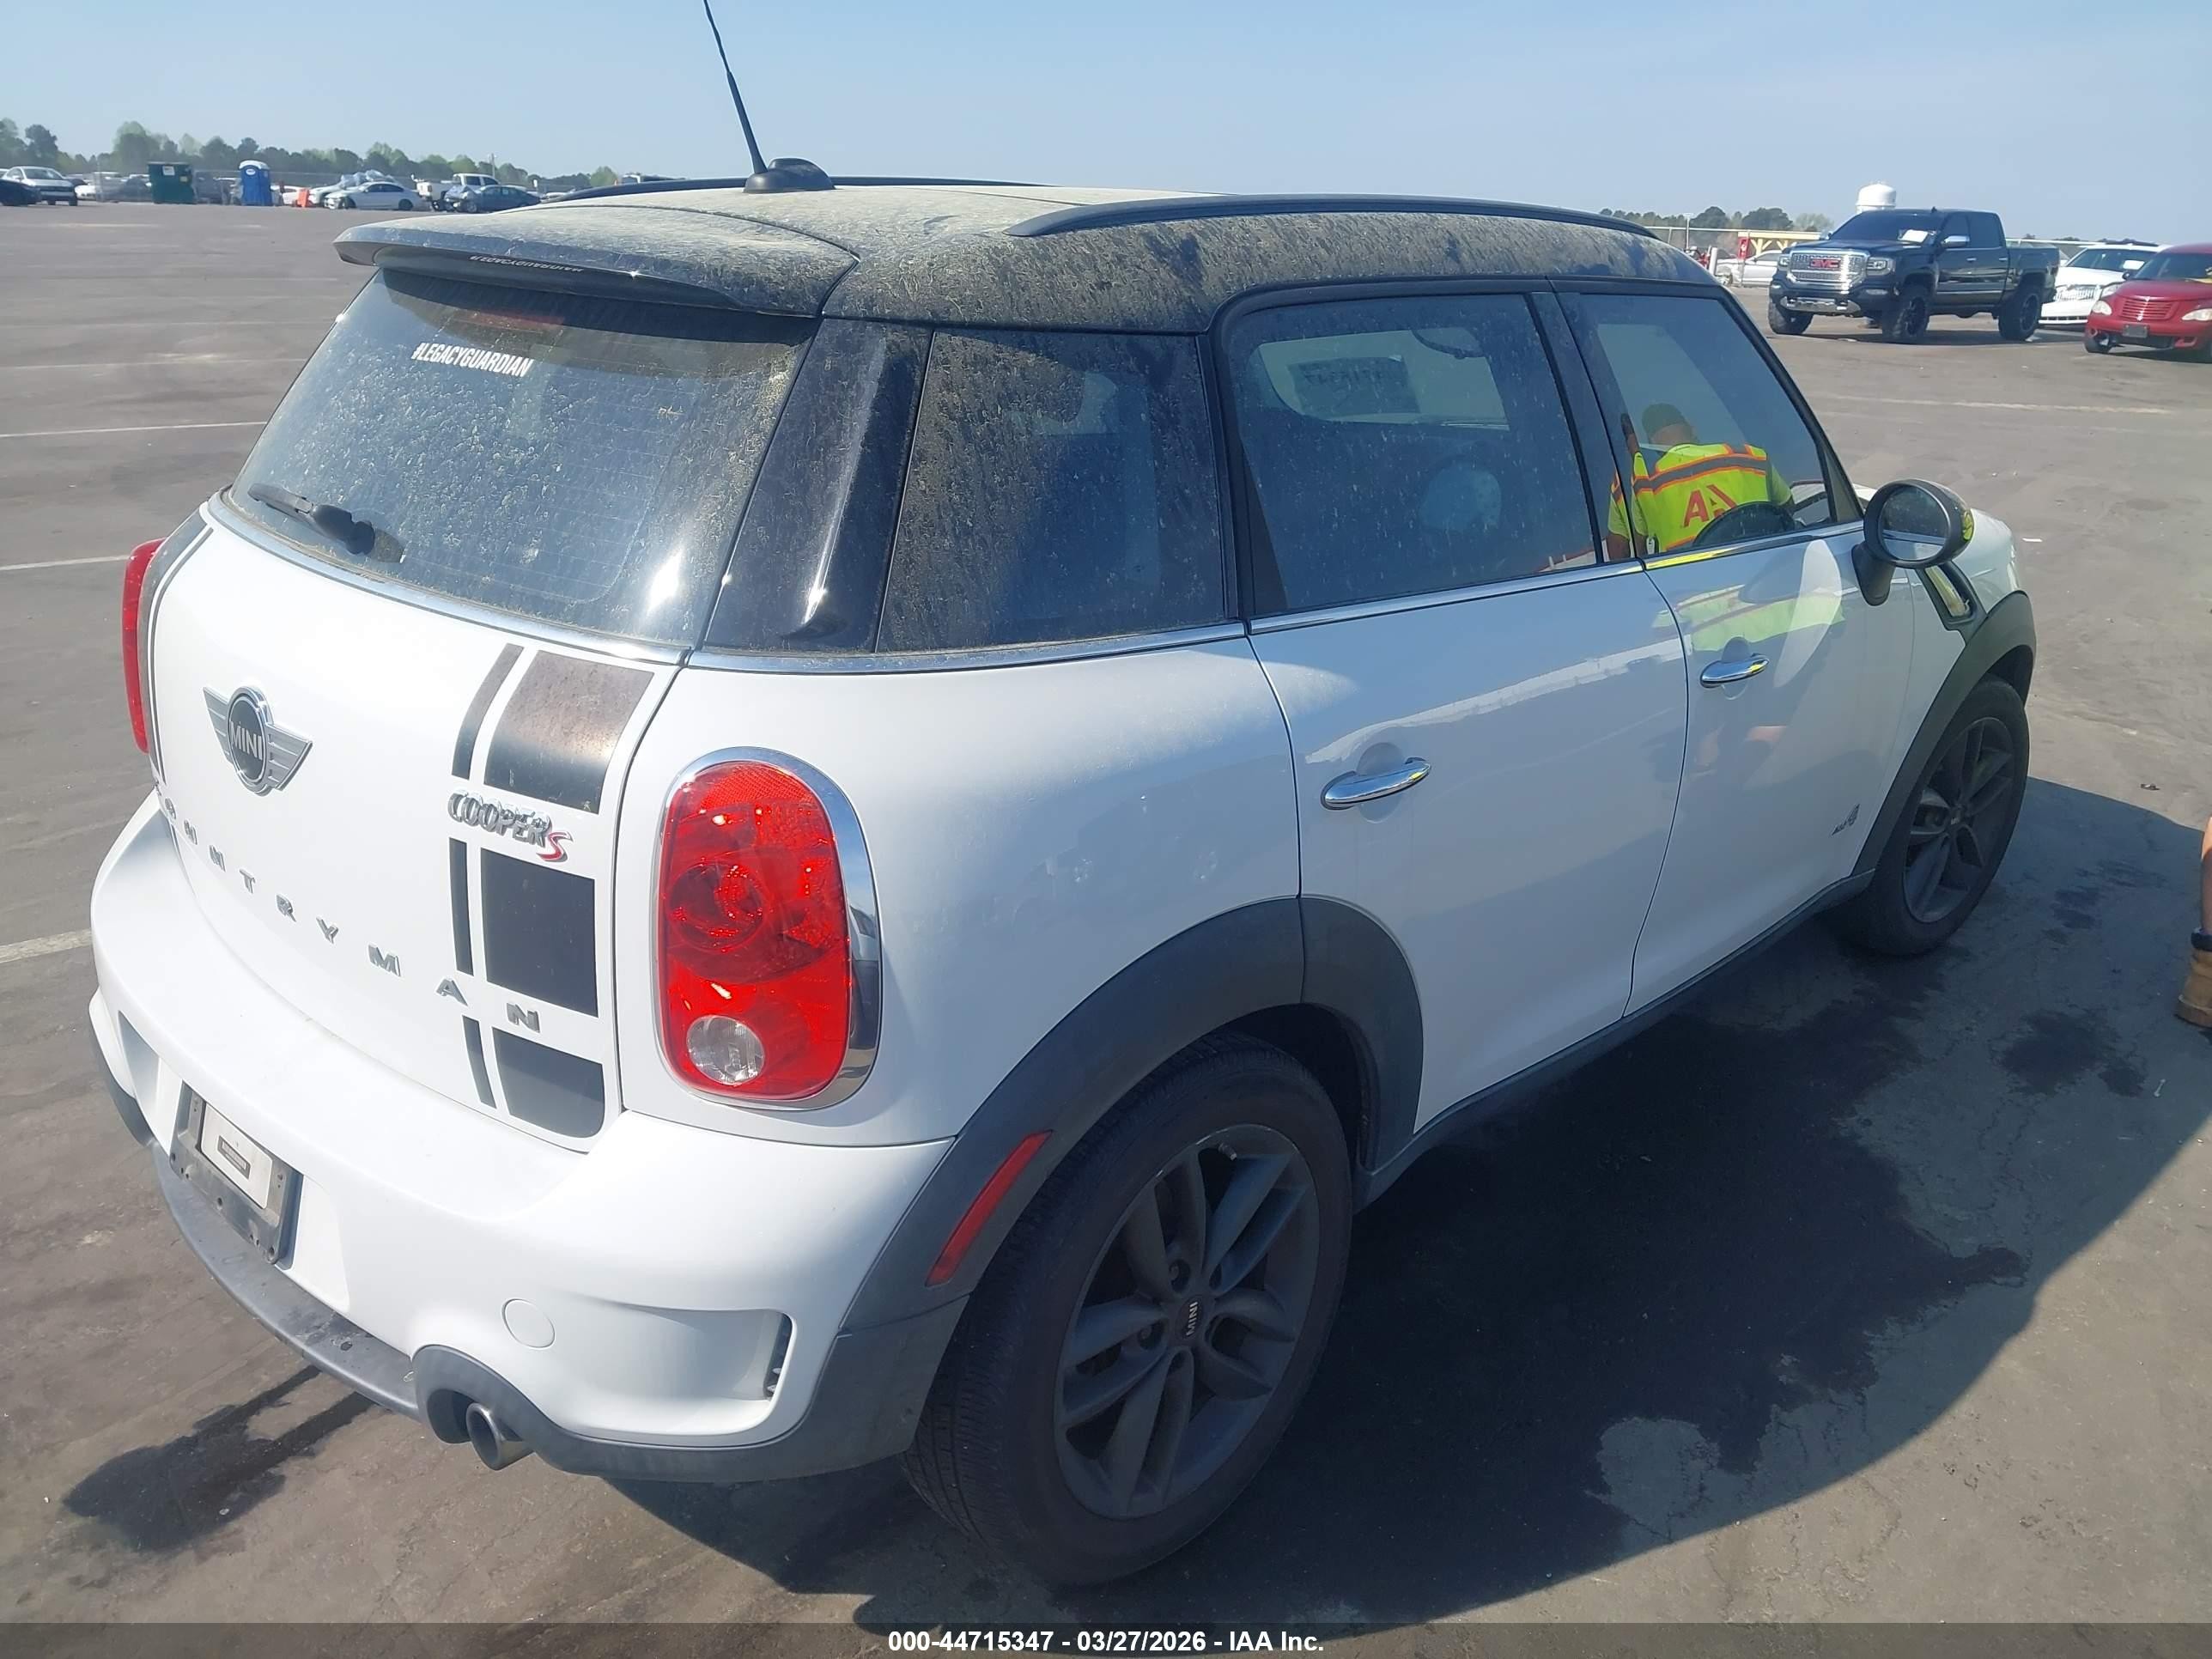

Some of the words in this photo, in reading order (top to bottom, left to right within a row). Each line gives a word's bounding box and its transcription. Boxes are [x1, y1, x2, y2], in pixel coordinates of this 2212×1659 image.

[1809, 258, 1840, 270] GMC
[411, 342, 534, 377] #LEGACYGUARDIAN
[229, 720, 263, 761] MINI
[447, 788, 552, 848] COOPER
[1186, 1301, 1199, 1336] MINI
